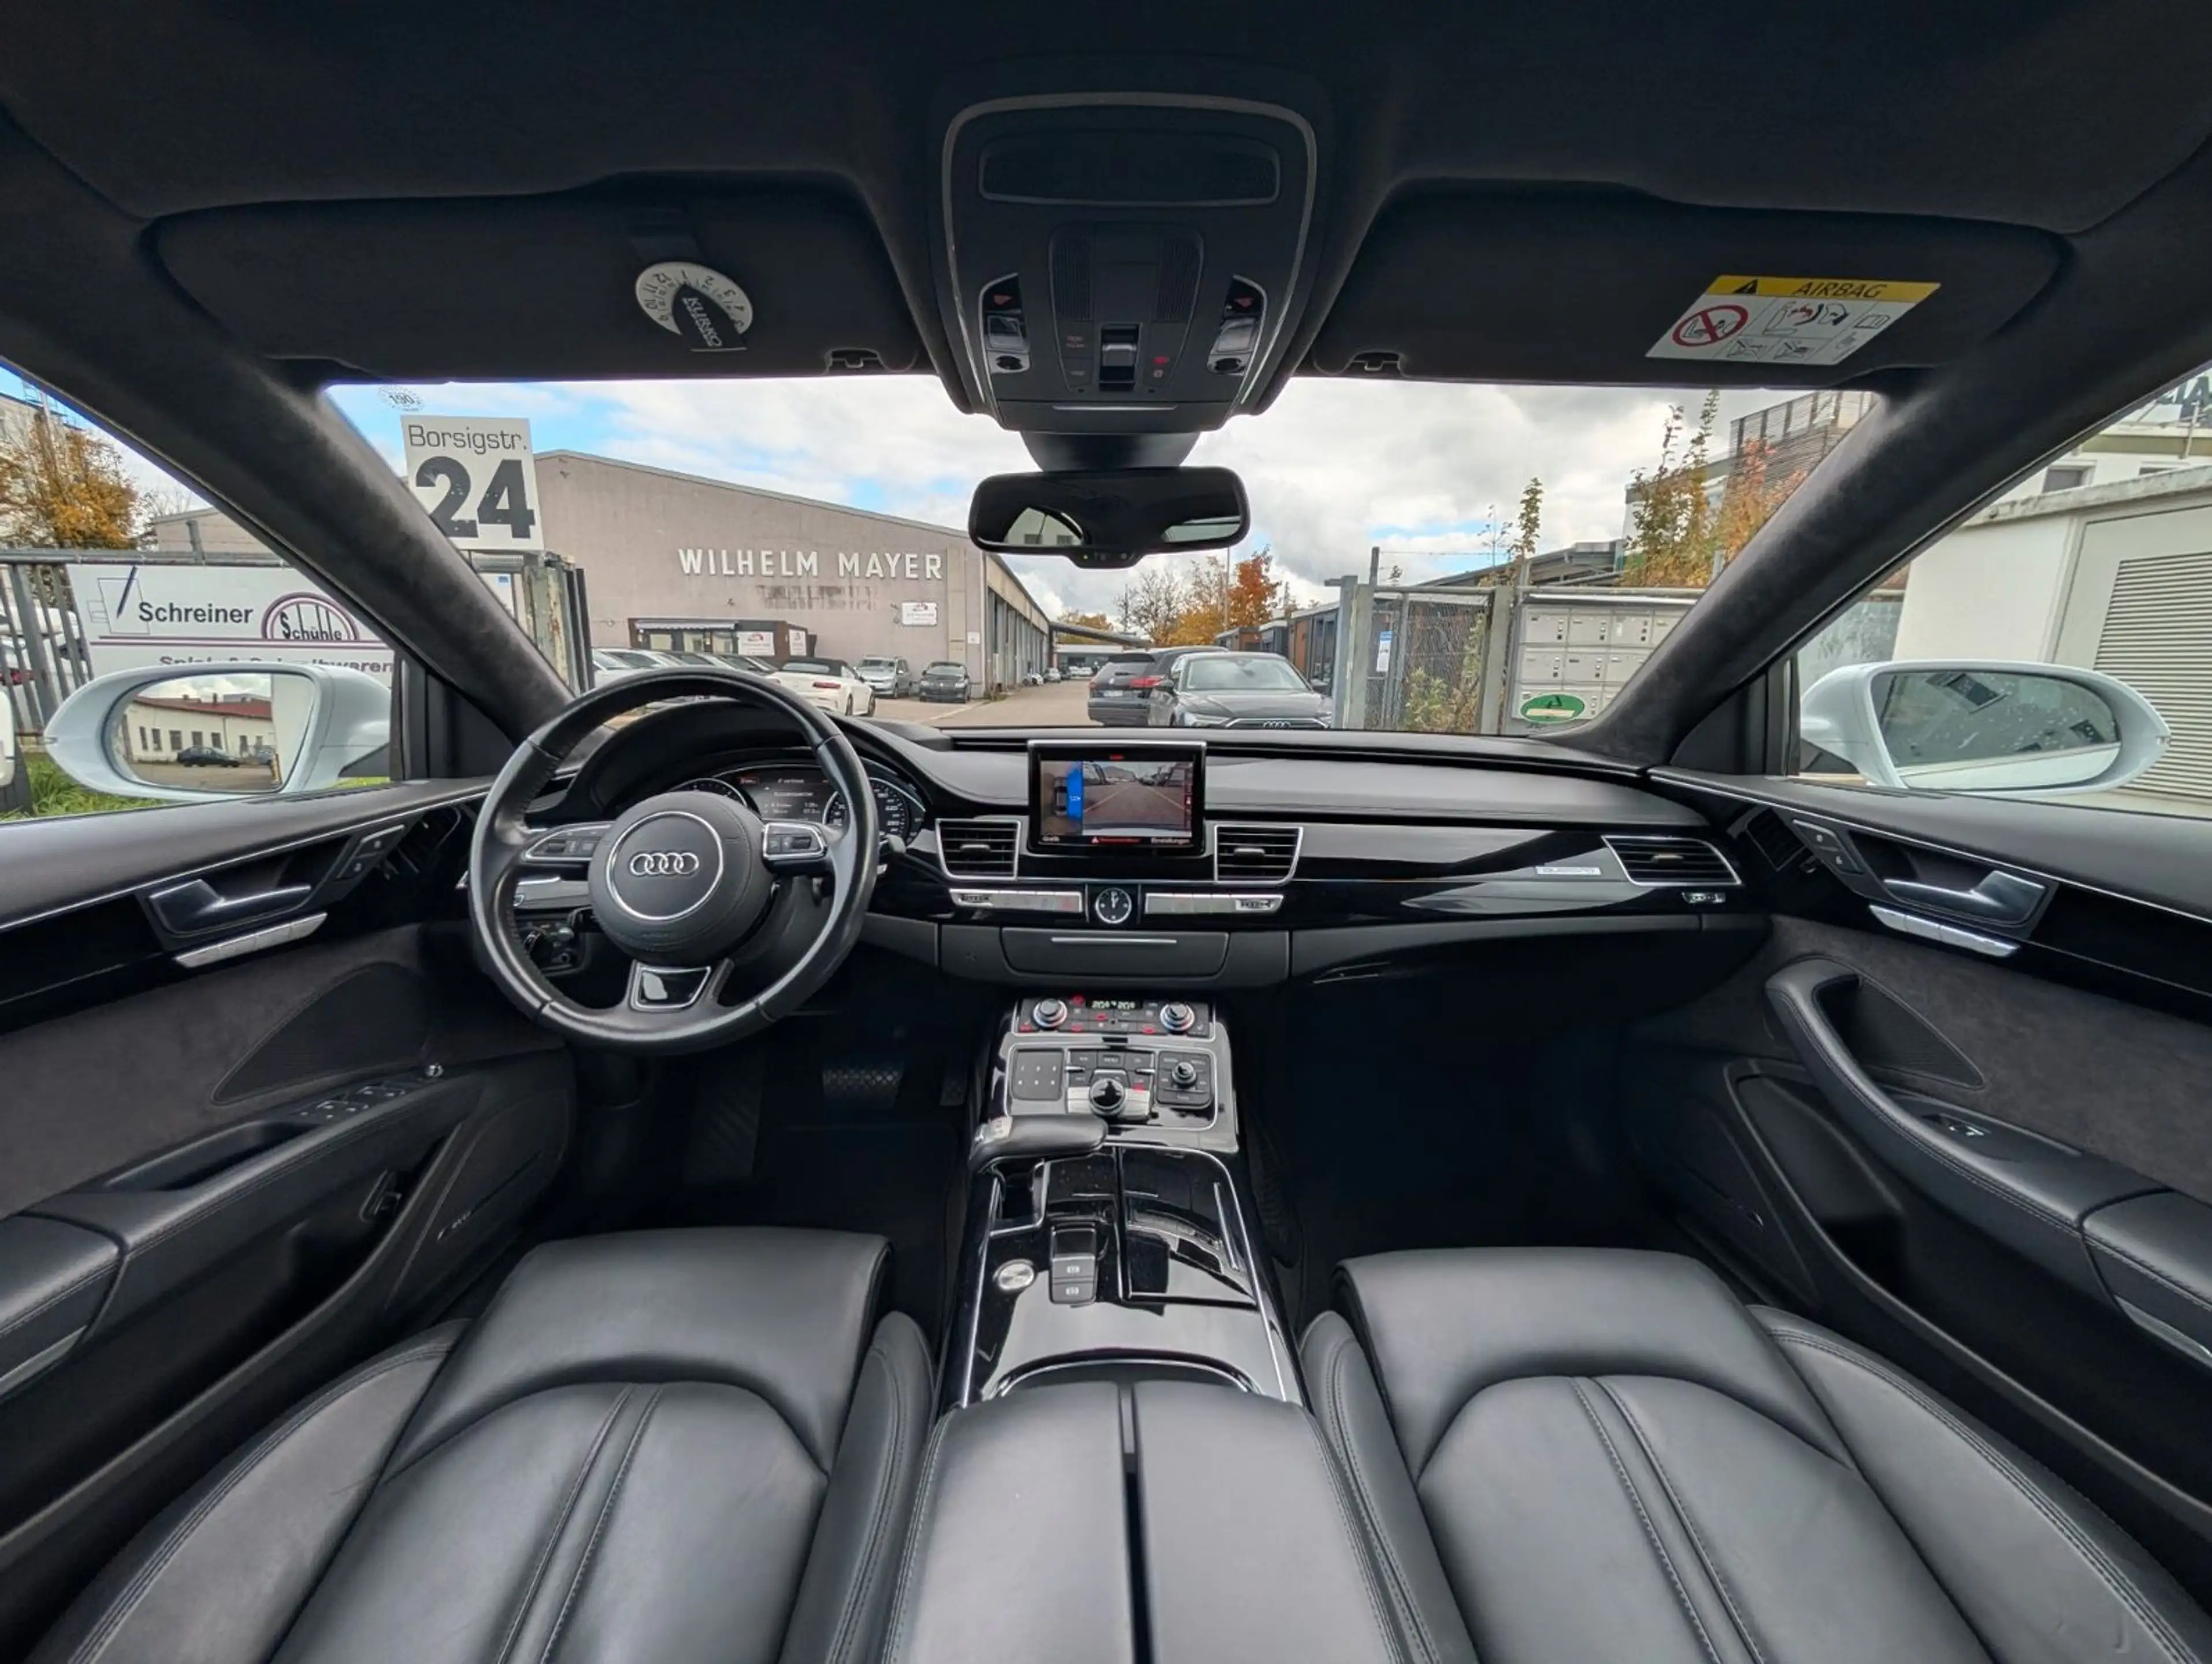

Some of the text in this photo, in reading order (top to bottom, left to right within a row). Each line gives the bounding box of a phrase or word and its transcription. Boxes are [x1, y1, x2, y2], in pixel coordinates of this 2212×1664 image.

[1791, 281, 1887, 298] AIRBAG
[408, 425, 527, 455] Borsigstr.
[415, 455, 536, 539] 24
[678, 548, 944, 580] WILHELM MAYER
[138, 601, 254, 624] Schreiner
